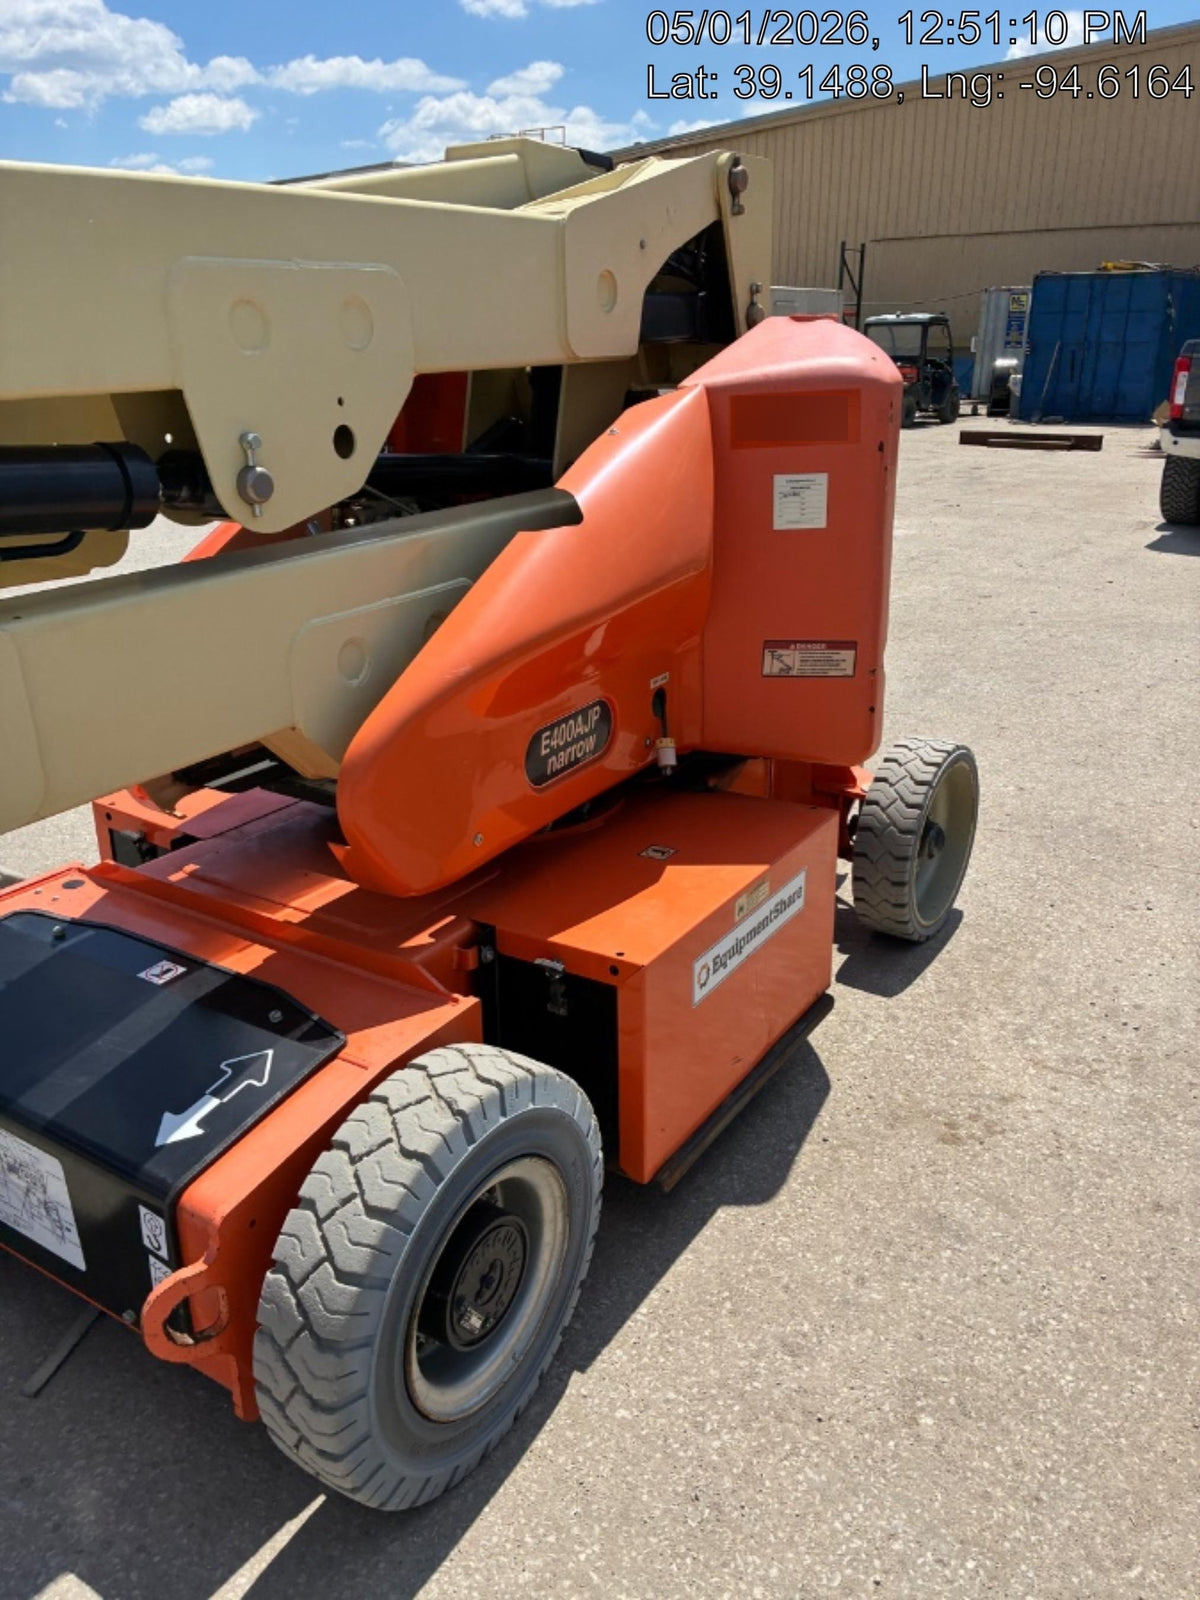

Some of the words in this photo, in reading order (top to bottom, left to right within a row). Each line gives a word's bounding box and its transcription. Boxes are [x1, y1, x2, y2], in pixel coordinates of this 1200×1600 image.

[541, 705, 601, 757] E400AJP
[547, 734, 597, 776] narrow
[712, 886, 803, 975] EquipmentShare
